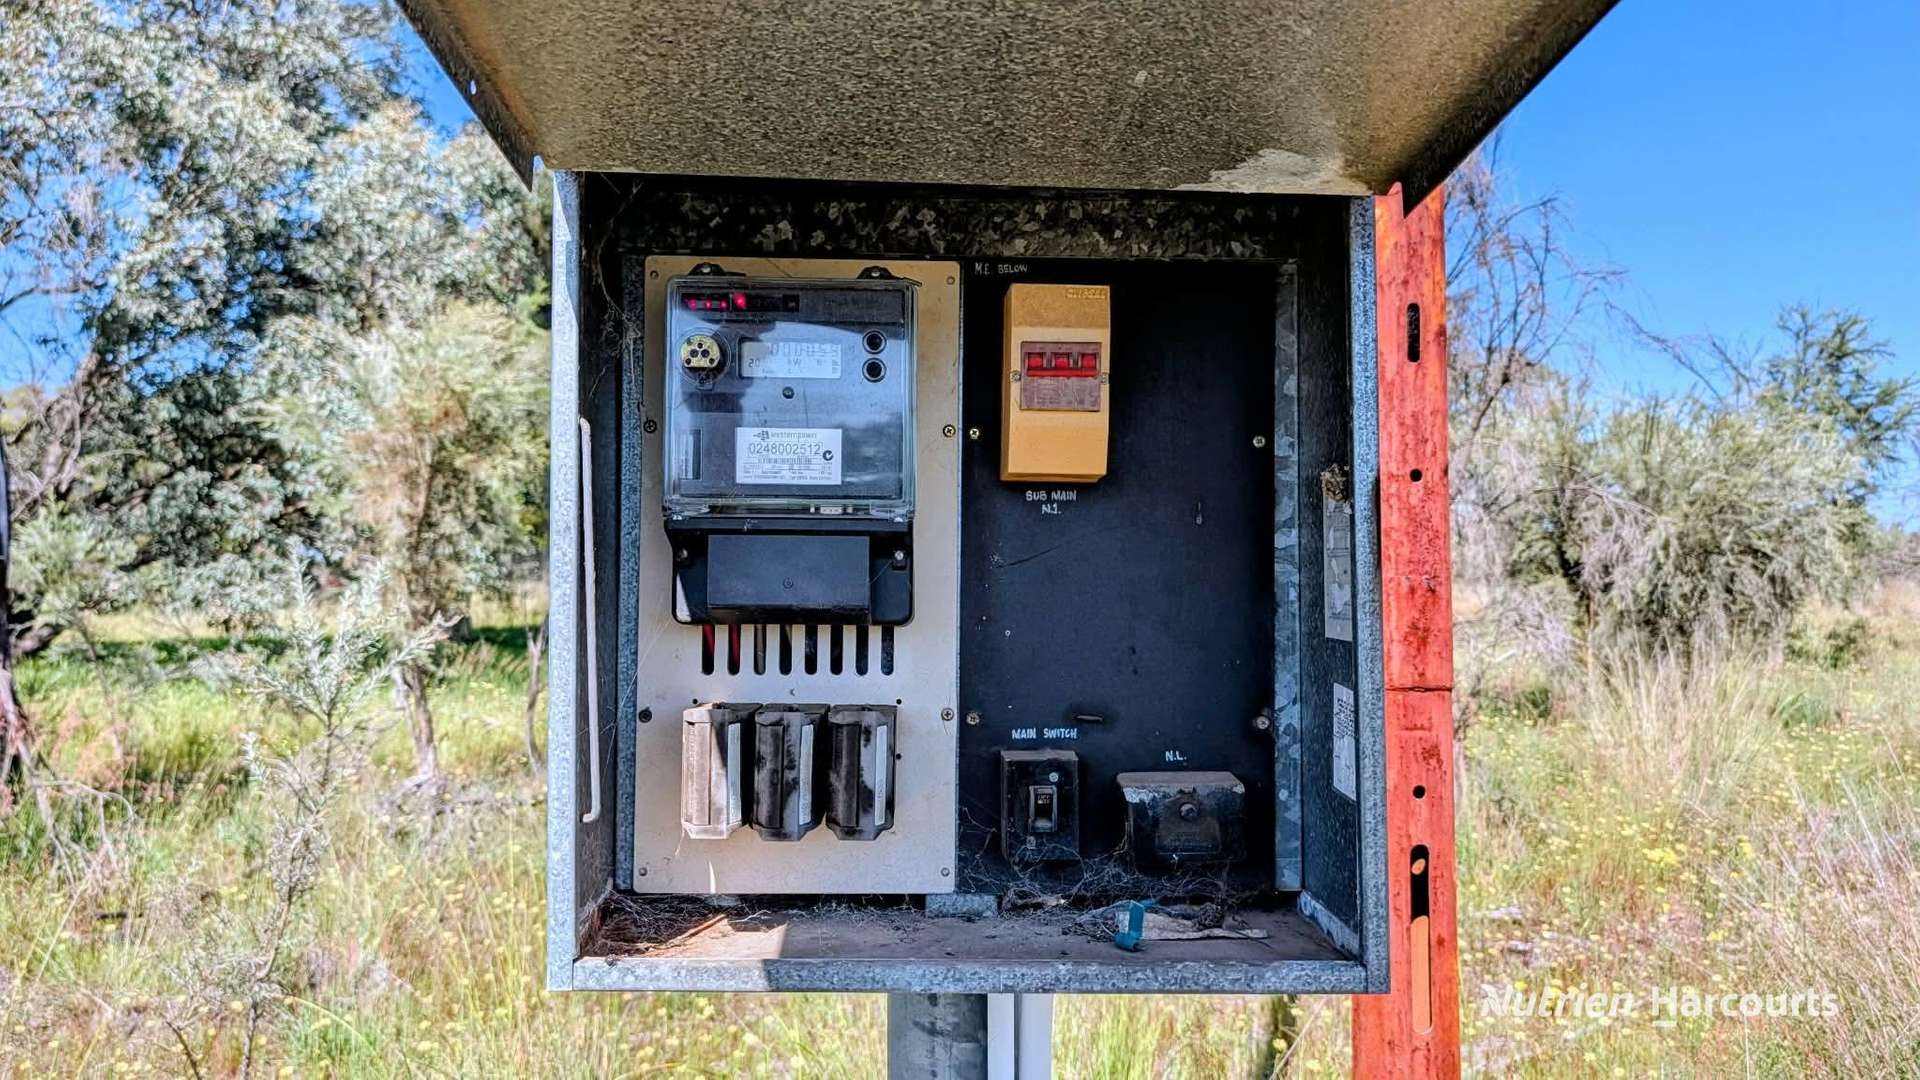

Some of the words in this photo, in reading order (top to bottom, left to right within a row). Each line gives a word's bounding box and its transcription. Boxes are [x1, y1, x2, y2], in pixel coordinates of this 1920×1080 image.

[998, 264, 1028, 274] BELOW
[748, 442, 821, 455] 0248002512
[1025, 490, 1047, 501] SUB
[1051, 490, 1077, 501] MAIN
[1011, 727, 1037, 739] MAIN
[1043, 727, 1078, 739] SWITCH
